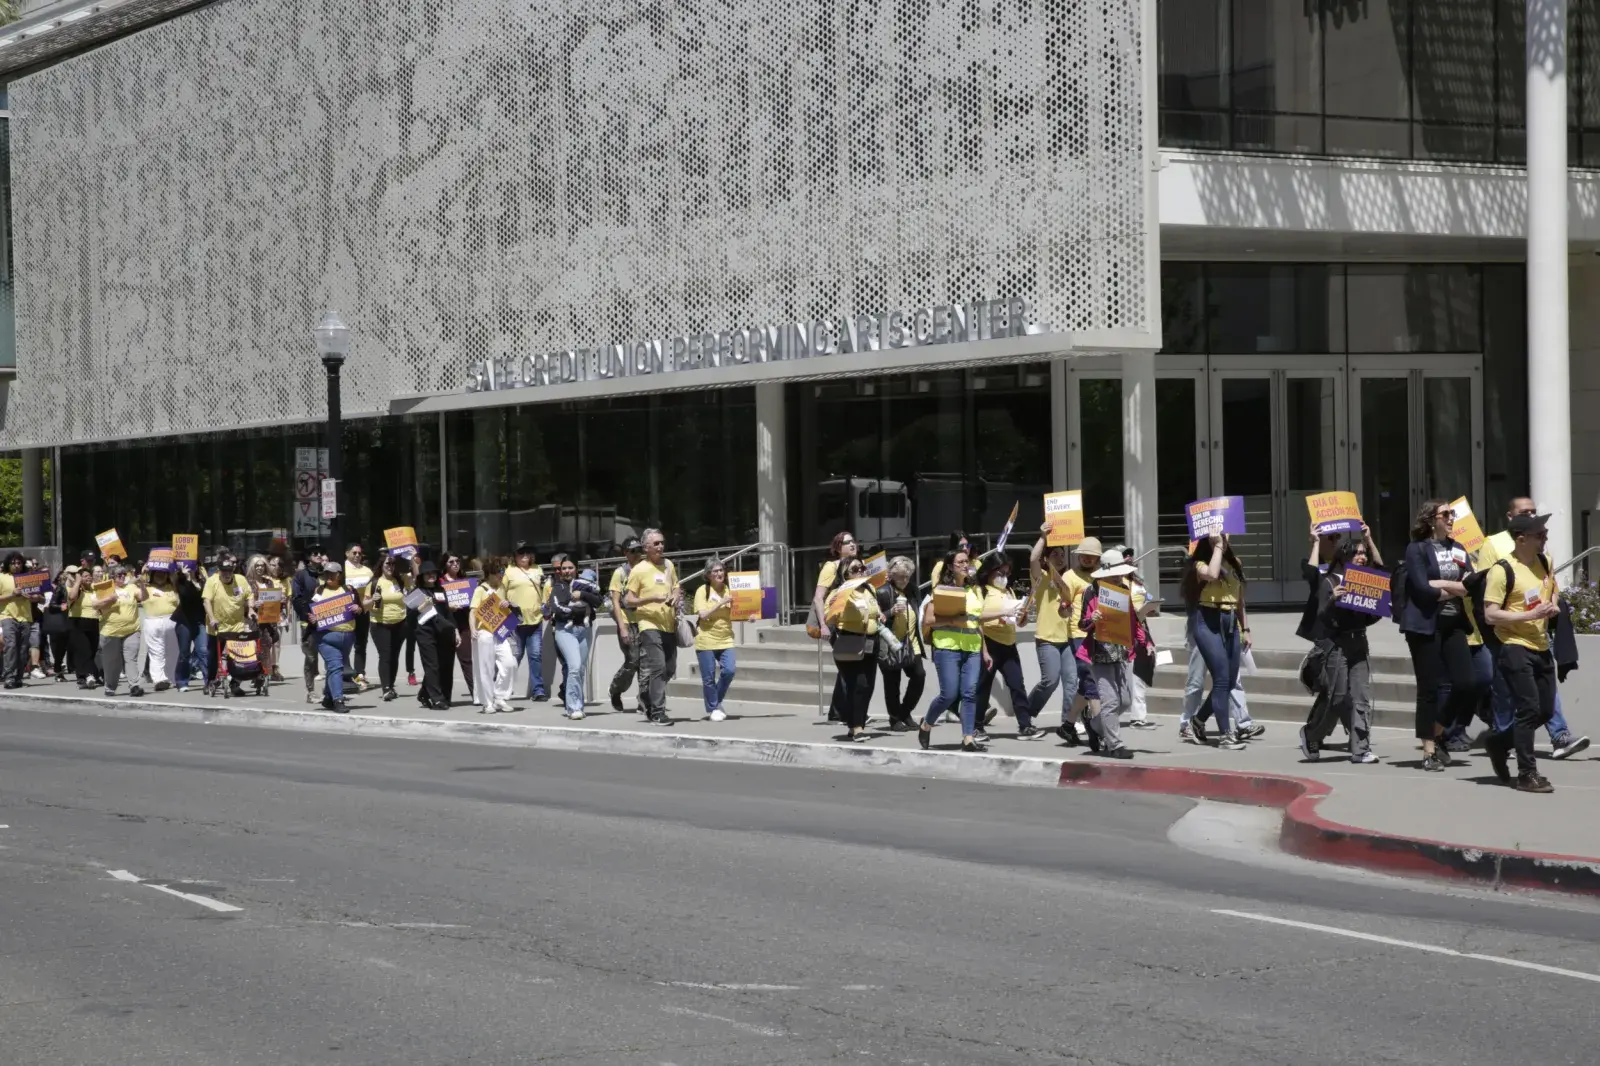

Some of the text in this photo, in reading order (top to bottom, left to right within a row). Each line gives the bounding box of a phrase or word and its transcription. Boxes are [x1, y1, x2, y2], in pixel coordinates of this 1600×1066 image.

[466, 296, 1028, 393] SAFE CREDIT UNION PERFORMING ARTS CENTER
[1193, 514, 1224, 529] DERECHO
[1194, 523, 1224, 538] HUMO
[175, 536, 195, 544] LOBBY
[1100, 588, 1110, 597] END
[1345, 582, 1384, 599] APRENDEN
[478, 596, 496, 617] LOBBY
[1341, 594, 1378, 610] EN CLASE
[317, 614, 346, 628] EN CLASE
[482, 609, 496, 622] DAY
[489, 611, 505, 628] 2024
